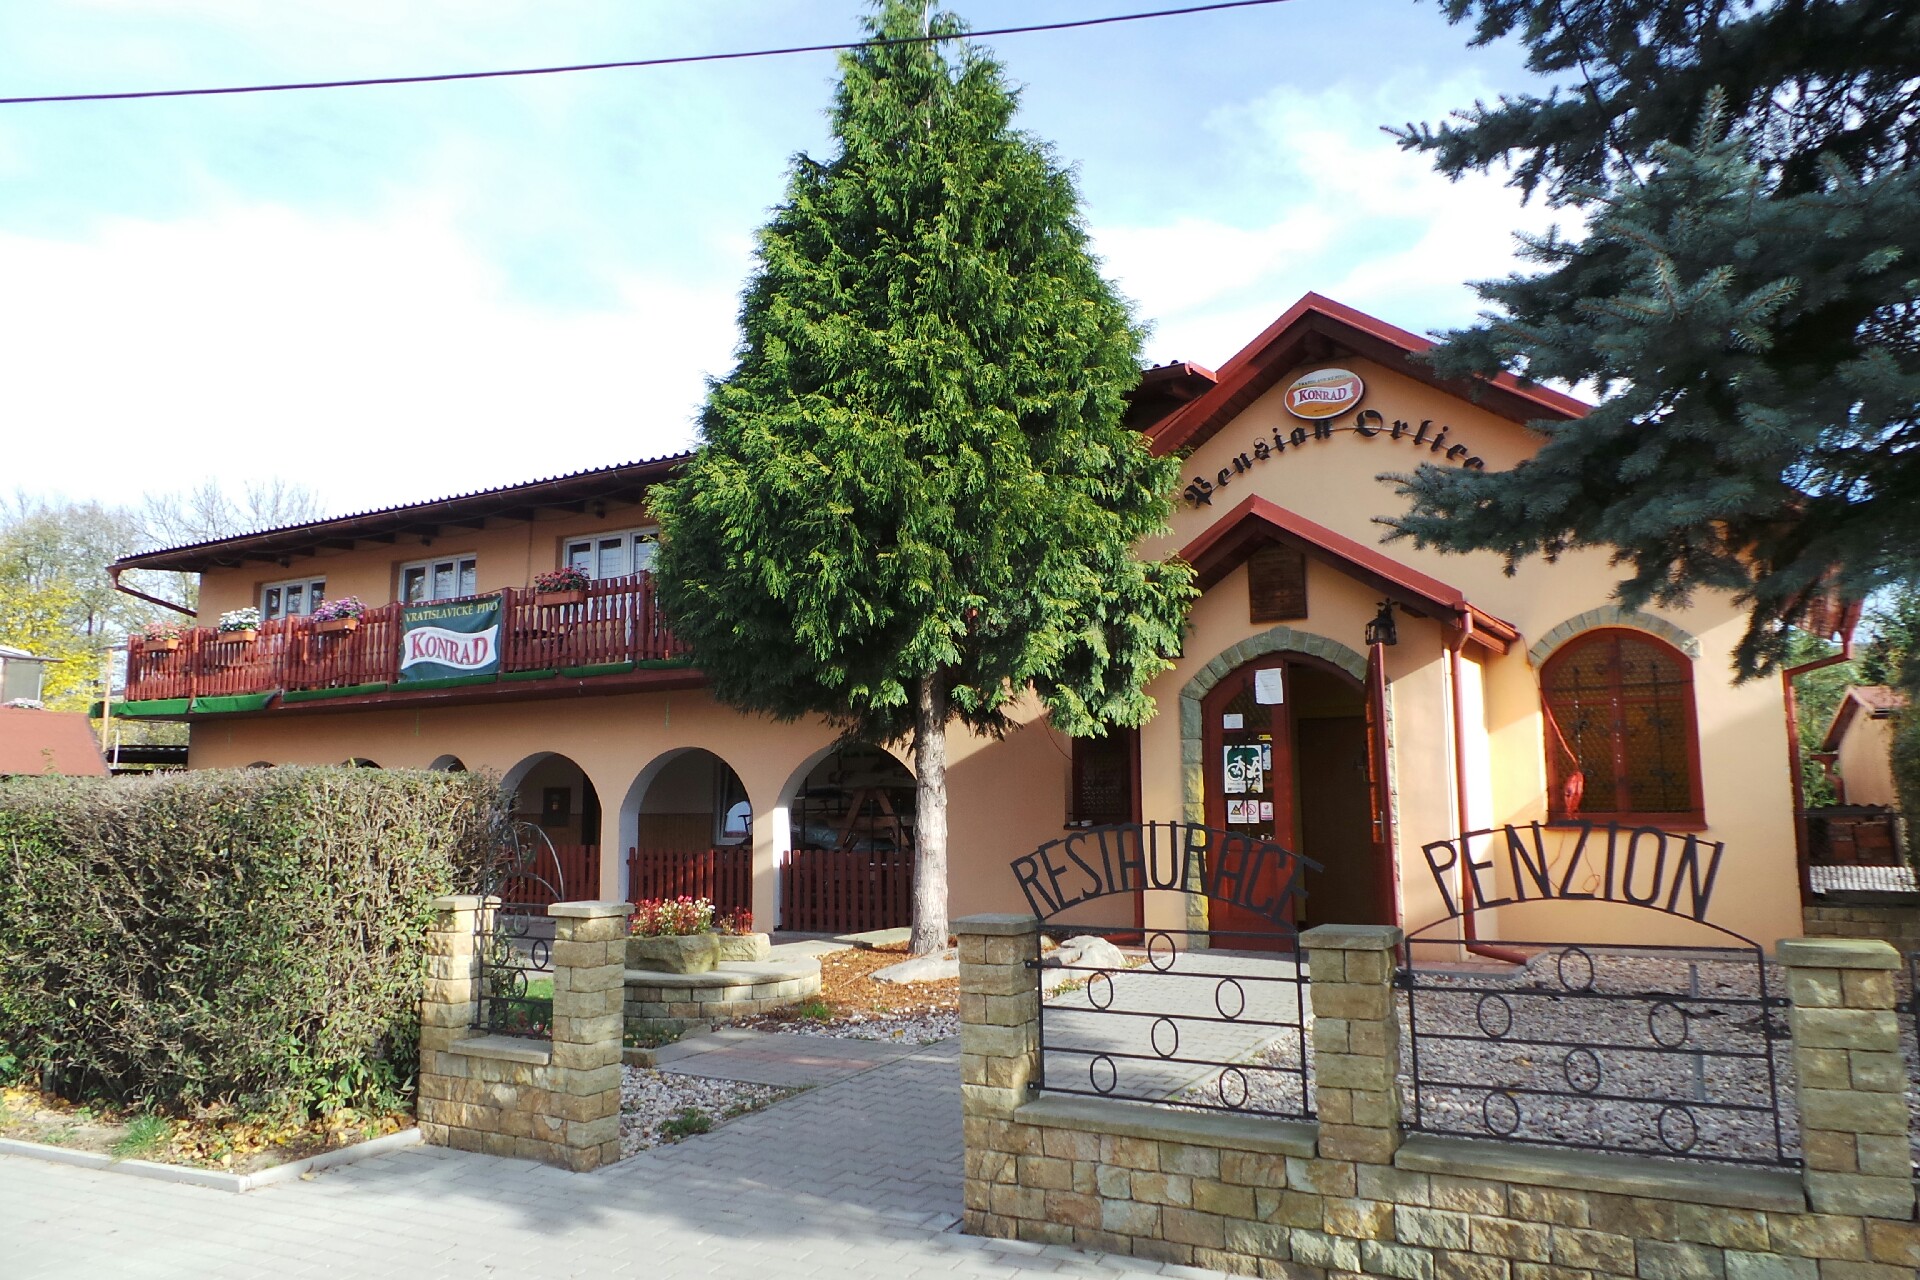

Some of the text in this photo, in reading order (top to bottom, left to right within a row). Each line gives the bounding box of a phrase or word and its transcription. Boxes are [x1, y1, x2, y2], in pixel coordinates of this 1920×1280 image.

[1299, 387, 1347, 402] KONRAD
[405, 601, 498, 622] VRATISLAVICKÉ PIVO
[410, 632, 488, 665] KONRAD
[1010, 820, 1324, 932] RESTAURACE
[1421, 820, 1724, 922] PENZION
